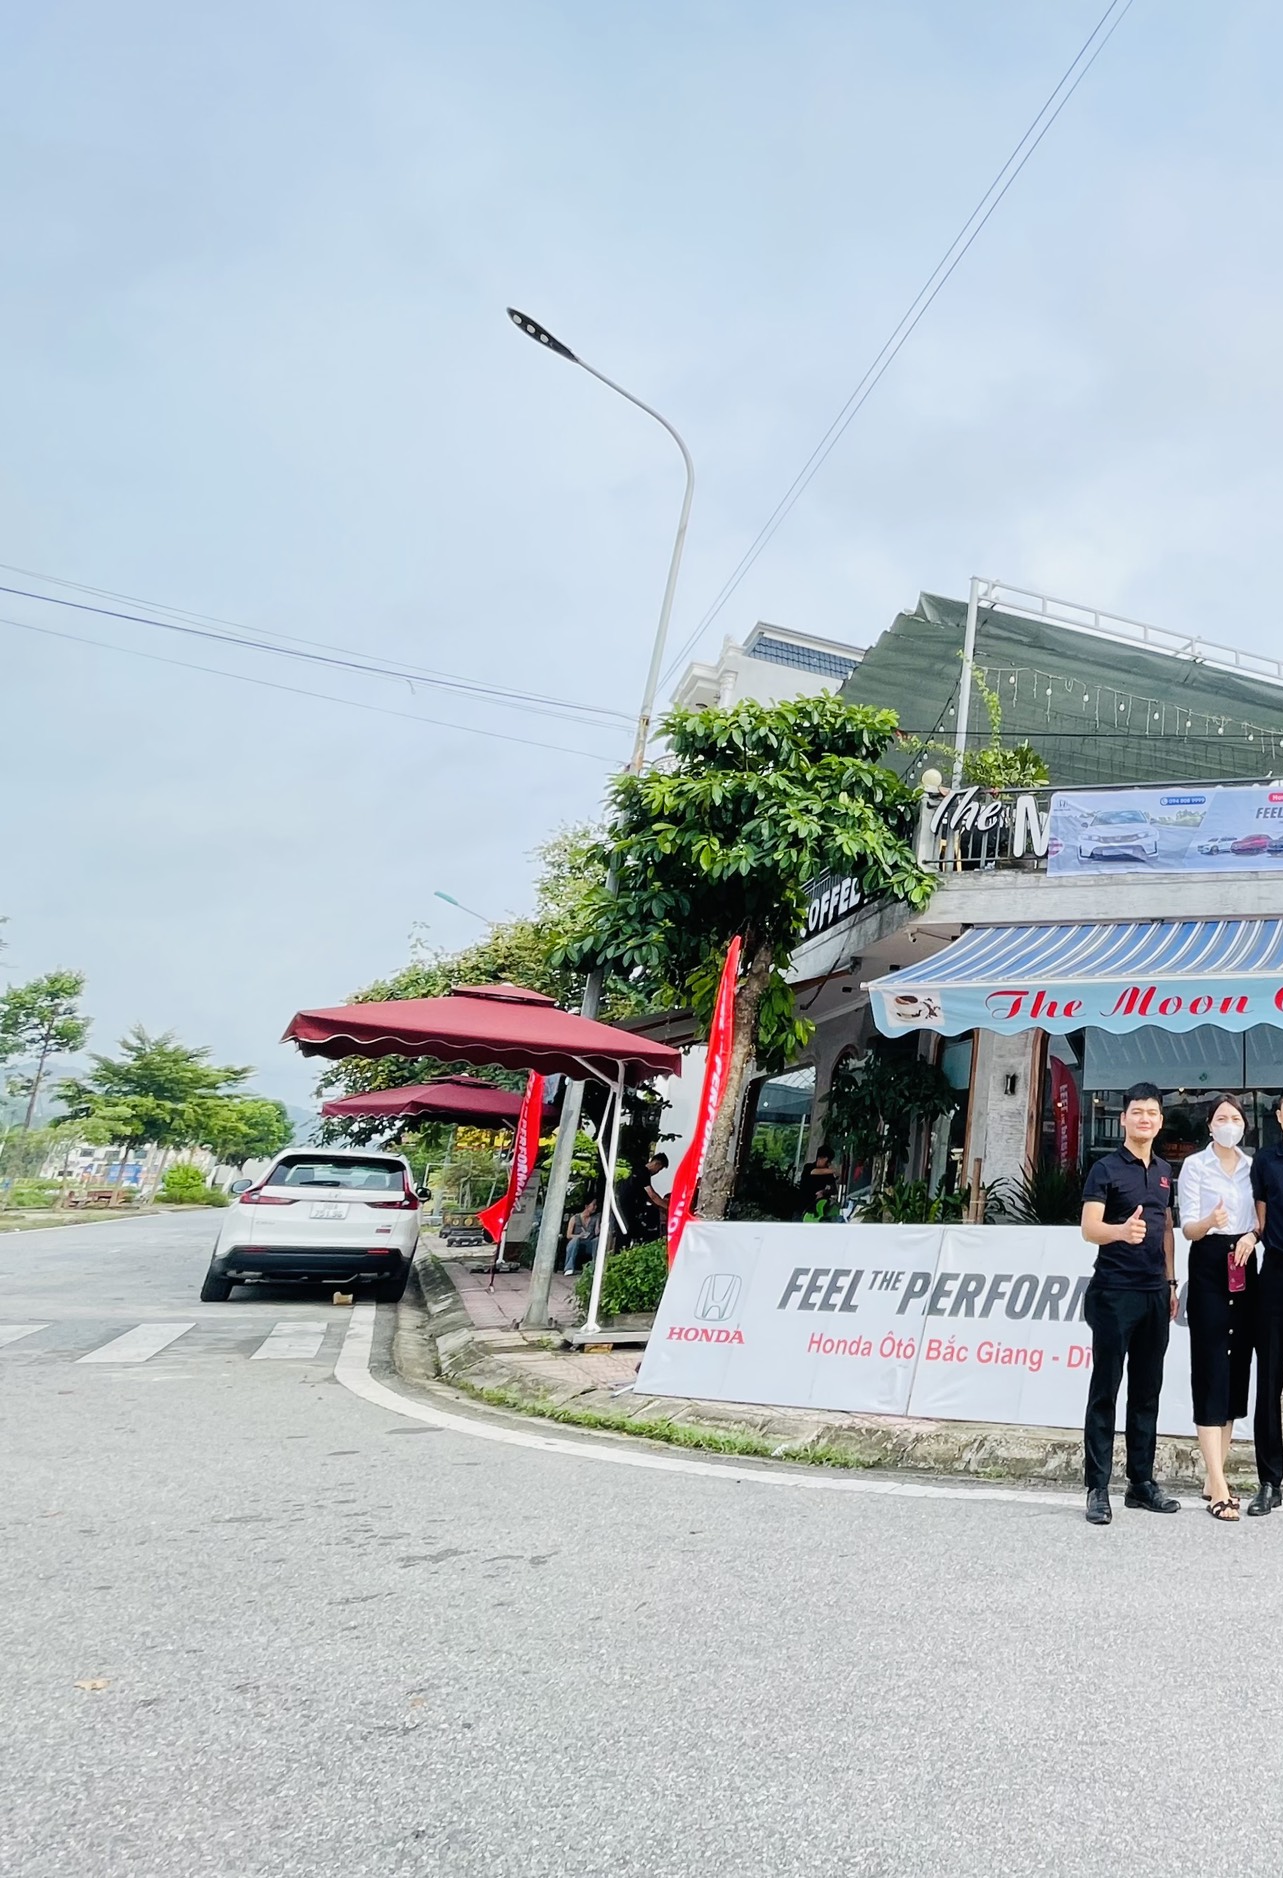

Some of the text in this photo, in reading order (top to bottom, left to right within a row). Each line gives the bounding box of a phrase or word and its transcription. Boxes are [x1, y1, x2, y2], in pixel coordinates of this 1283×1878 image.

[930, 785, 1002, 834] The
[1256, 805, 1283, 819] FEEL
[984, 988, 1087, 1020] The
[1099, 985, 1251, 1017] Moon
[776, 1267, 1087, 1322] FEEL THE PERFOR
[666, 1325, 745, 1345] HONDA
[807, 1331, 873, 1359] Honda
[879, 1330, 915, 1360] Ôtô
[925, 1336, 968, 1364] Bắc
[976, 1340, 1044, 1371] Giang
